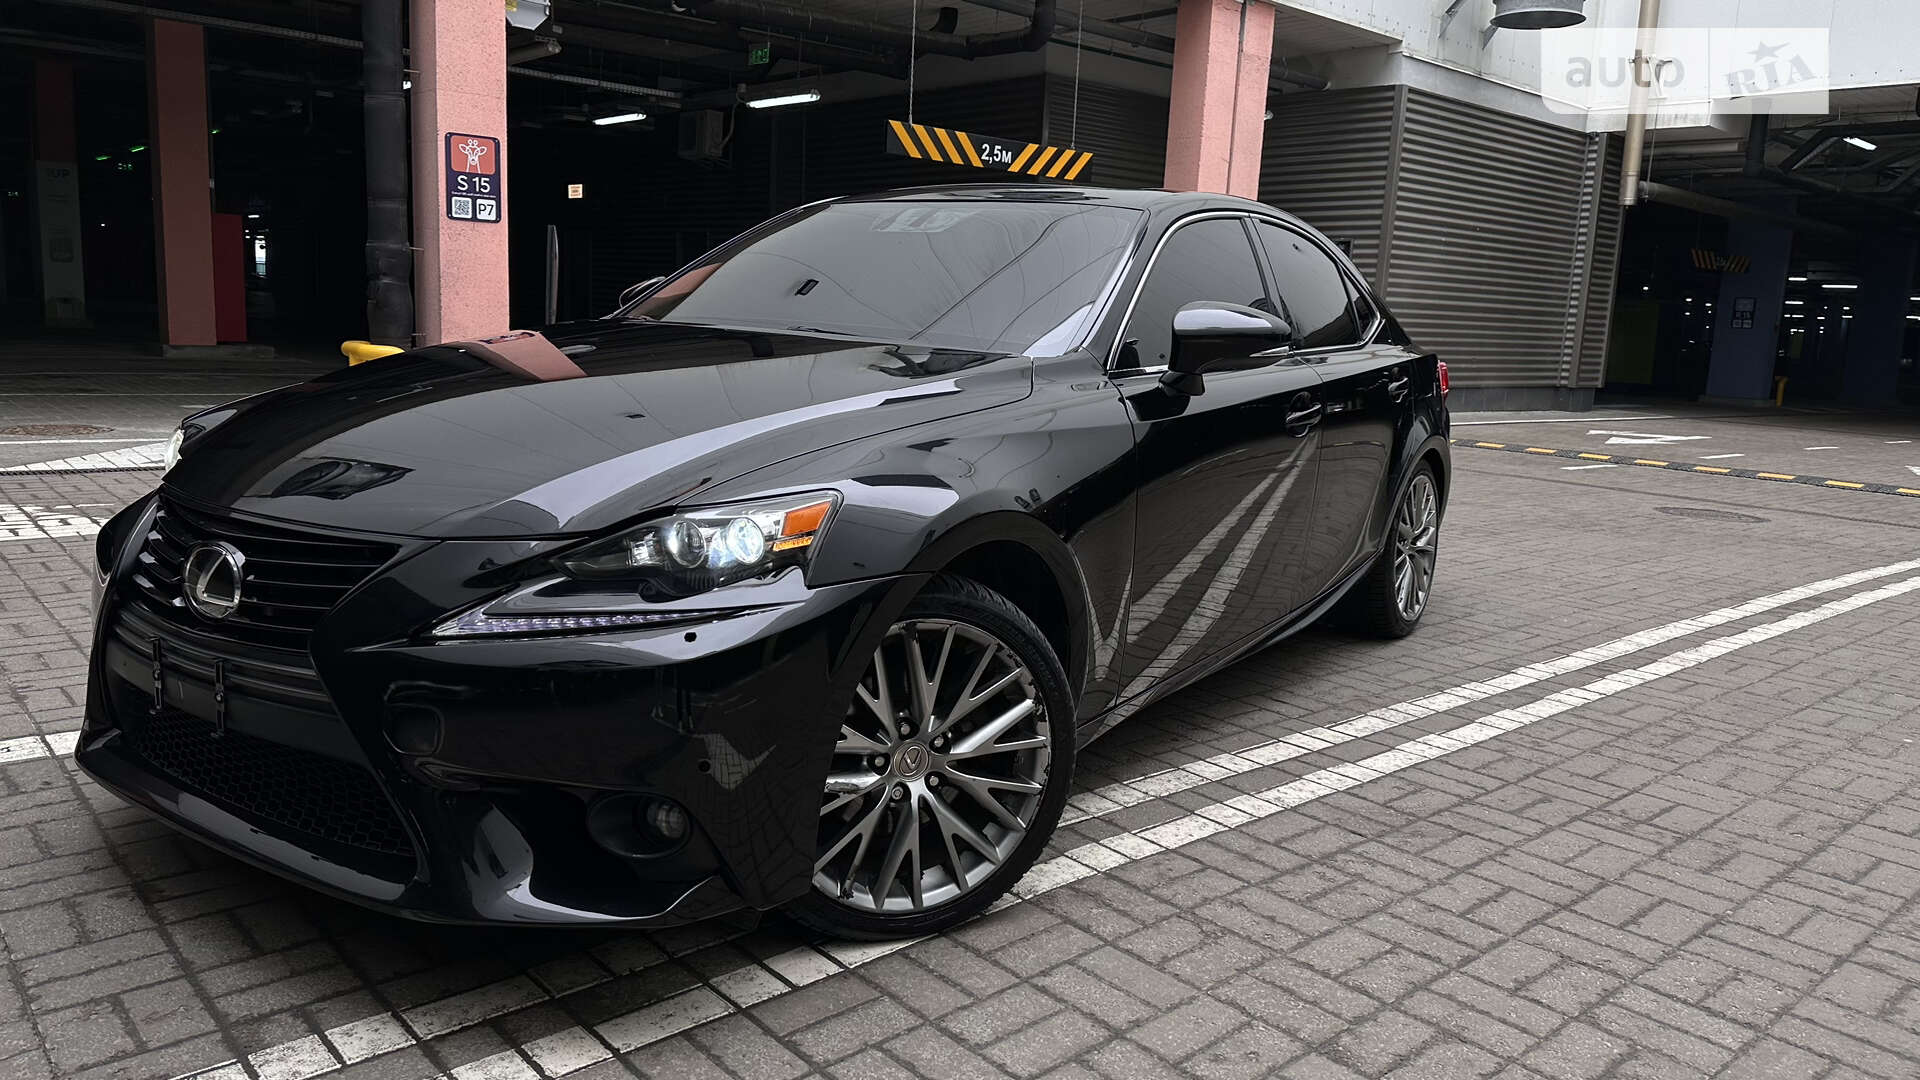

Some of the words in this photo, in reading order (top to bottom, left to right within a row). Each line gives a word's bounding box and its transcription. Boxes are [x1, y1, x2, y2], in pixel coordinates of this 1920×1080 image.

[457, 175, 469, 191] S
[472, 176, 491, 193] 15
[478, 203, 494, 216] P7
